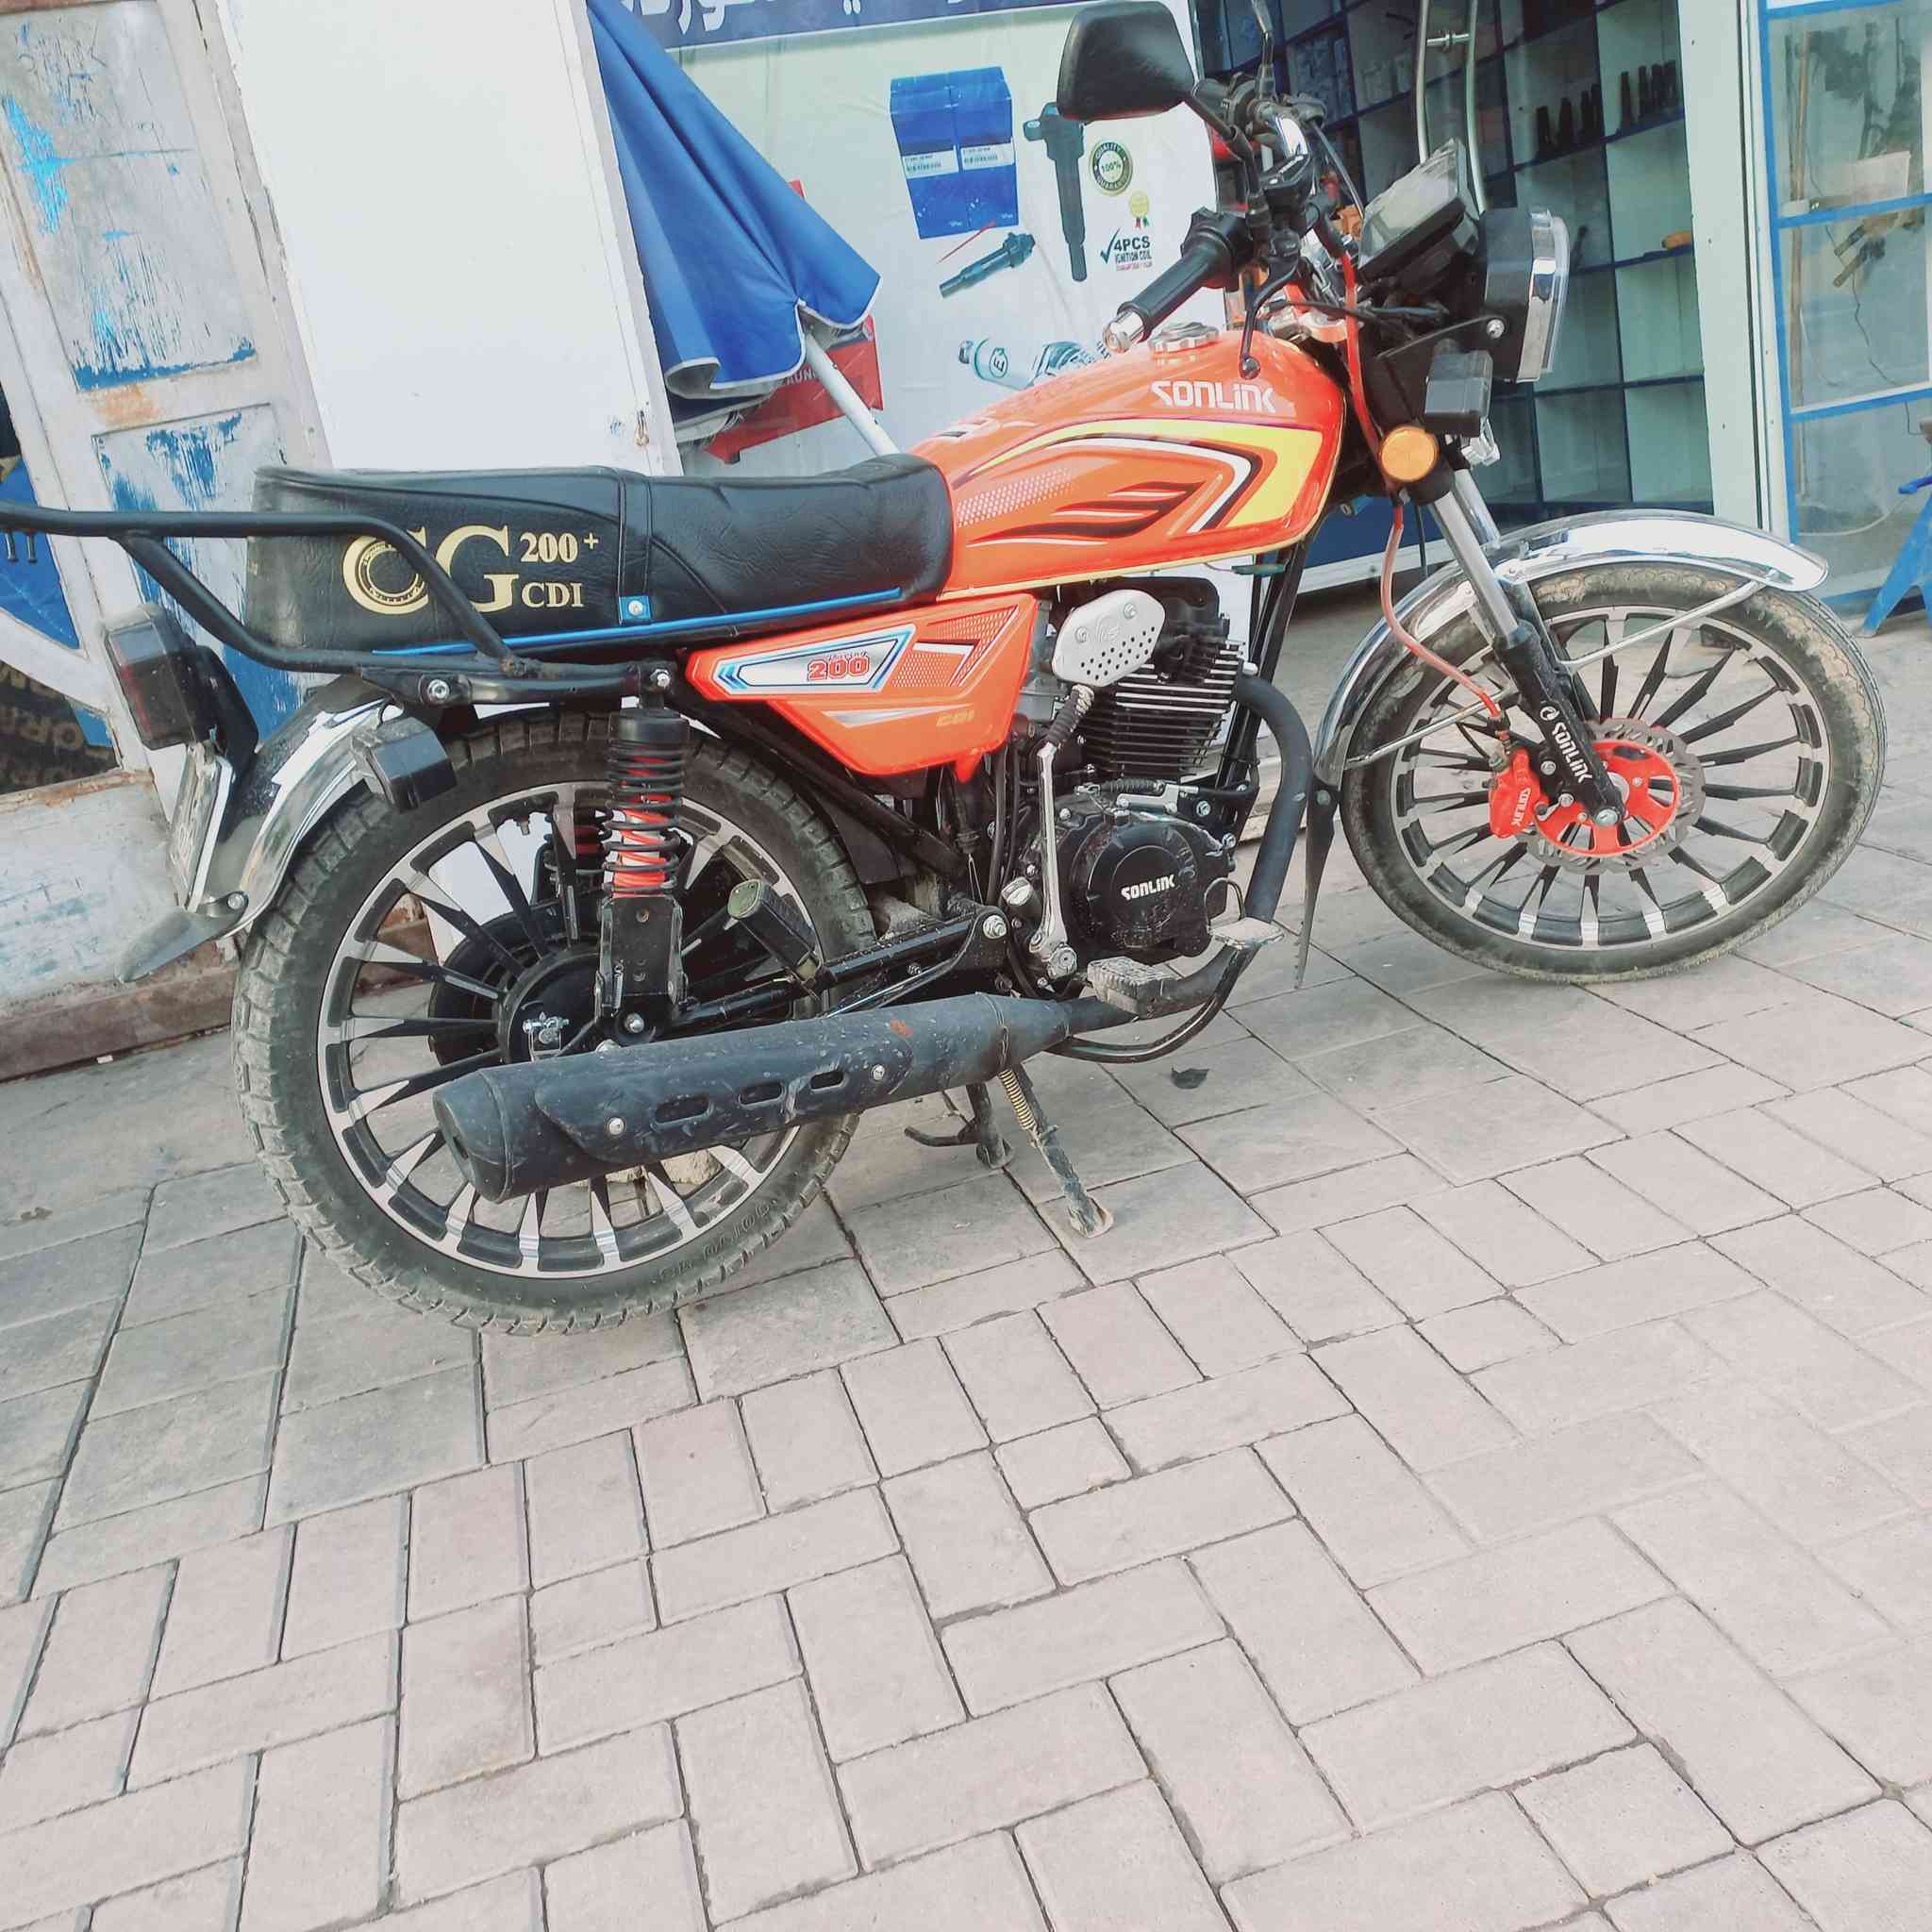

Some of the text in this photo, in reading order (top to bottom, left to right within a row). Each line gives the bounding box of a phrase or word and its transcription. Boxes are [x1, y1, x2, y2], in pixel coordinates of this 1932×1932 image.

[1101, 161, 1122, 174] 100%
[1114, 236, 1150, 252] 4PCS
[342, 525, 519, 614] CG
[521, 582, 584, 608] CDI
[808, 656, 870, 682] 200
[1552, 722, 1592, 784] SONLINK
[1121, 874, 1175, 901] SONLINK
